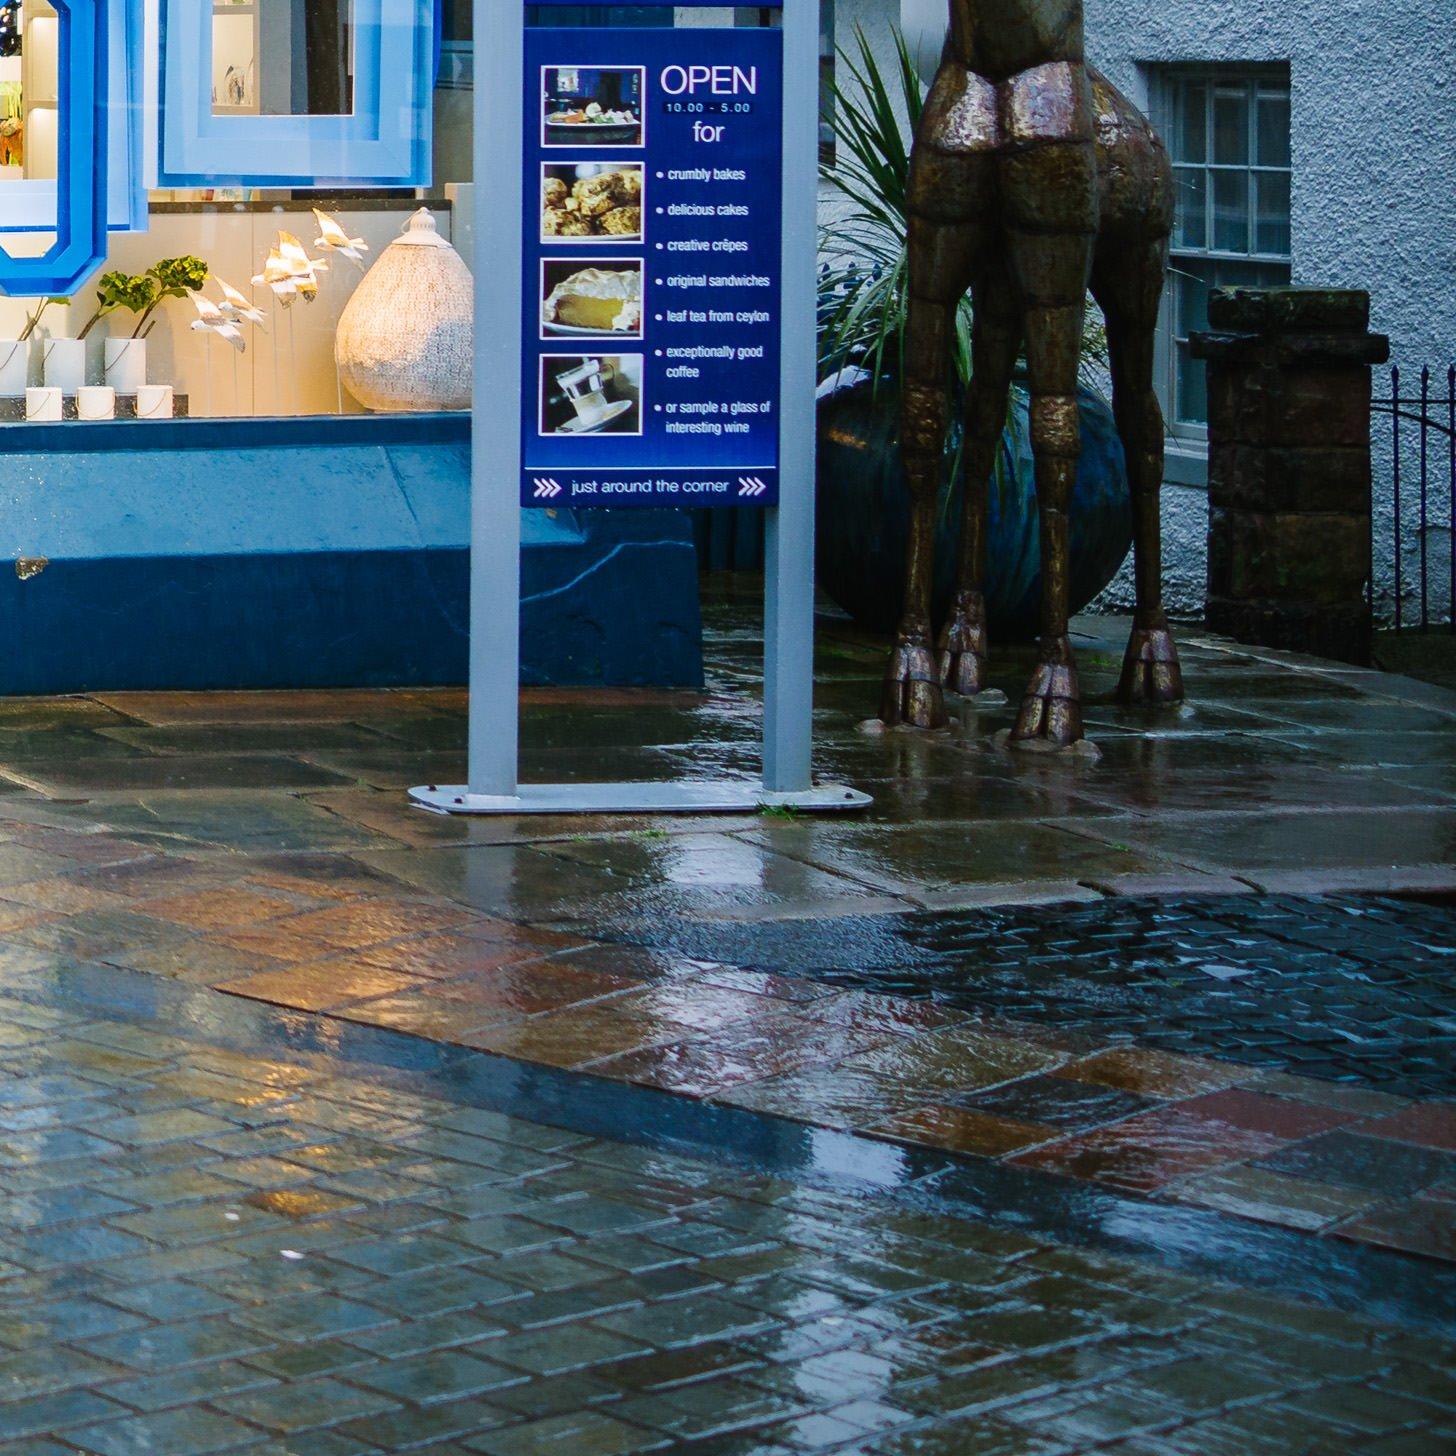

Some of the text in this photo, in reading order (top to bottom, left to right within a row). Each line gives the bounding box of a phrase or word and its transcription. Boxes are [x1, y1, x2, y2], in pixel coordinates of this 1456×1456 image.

[660, 65, 756, 95] OPEN
[667, 103, 704, 113] 10.00
[721, 103, 750, 113] 5.00
[692, 121, 726, 142] for
[668, 168, 746, 182] crumbly bakes
[668, 204, 749, 215] delicious cakes
[667, 239, 710, 251] creative
[667, 275, 770, 289] original sandwiches
[667, 310, 770, 324] leaf tea from ceylon
[666, 345, 763, 360] exceptionally good
[666, 365, 700, 378] coffee
[666, 401, 771, 415] or sample a glass of
[665, 421, 749, 436] interesting wine
[571, 479, 729, 496] just around the corner
